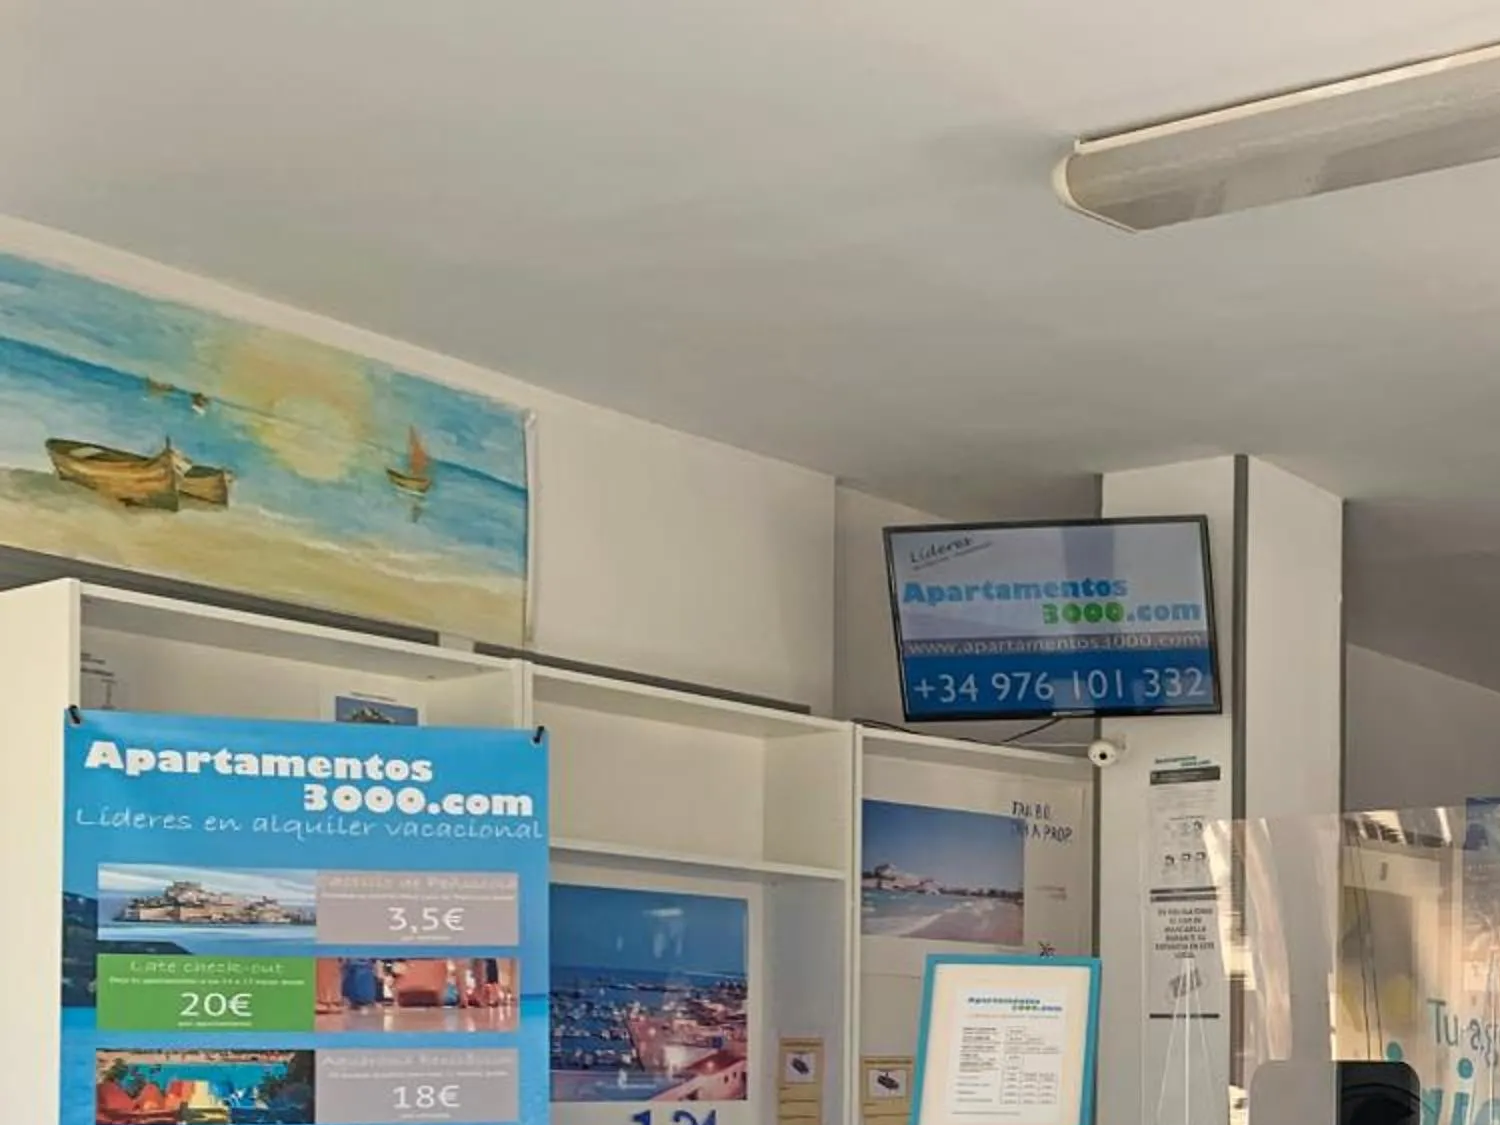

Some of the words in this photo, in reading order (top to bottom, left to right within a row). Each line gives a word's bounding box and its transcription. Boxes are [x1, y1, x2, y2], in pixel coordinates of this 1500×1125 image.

[902, 578, 1128, 605] Apartamentos
[1042, 602, 1201, 626] 3000.com
[914, 673, 979, 703] +34
[991, 671, 1055, 701] 976
[1071, 669, 1124, 701] 101
[1143, 667, 1205, 698] 332
[84, 740, 433, 782] Apartamentos
[303, 783, 534, 817] 3000.com
[203, 815, 240, 833] en
[252, 817, 377, 842] alquiler
[385, 817, 543, 840] vacacional
[388, 907, 465, 933] 3,5€
[180, 992, 254, 1017] 20€
[393, 1084, 461, 1109] 18€
